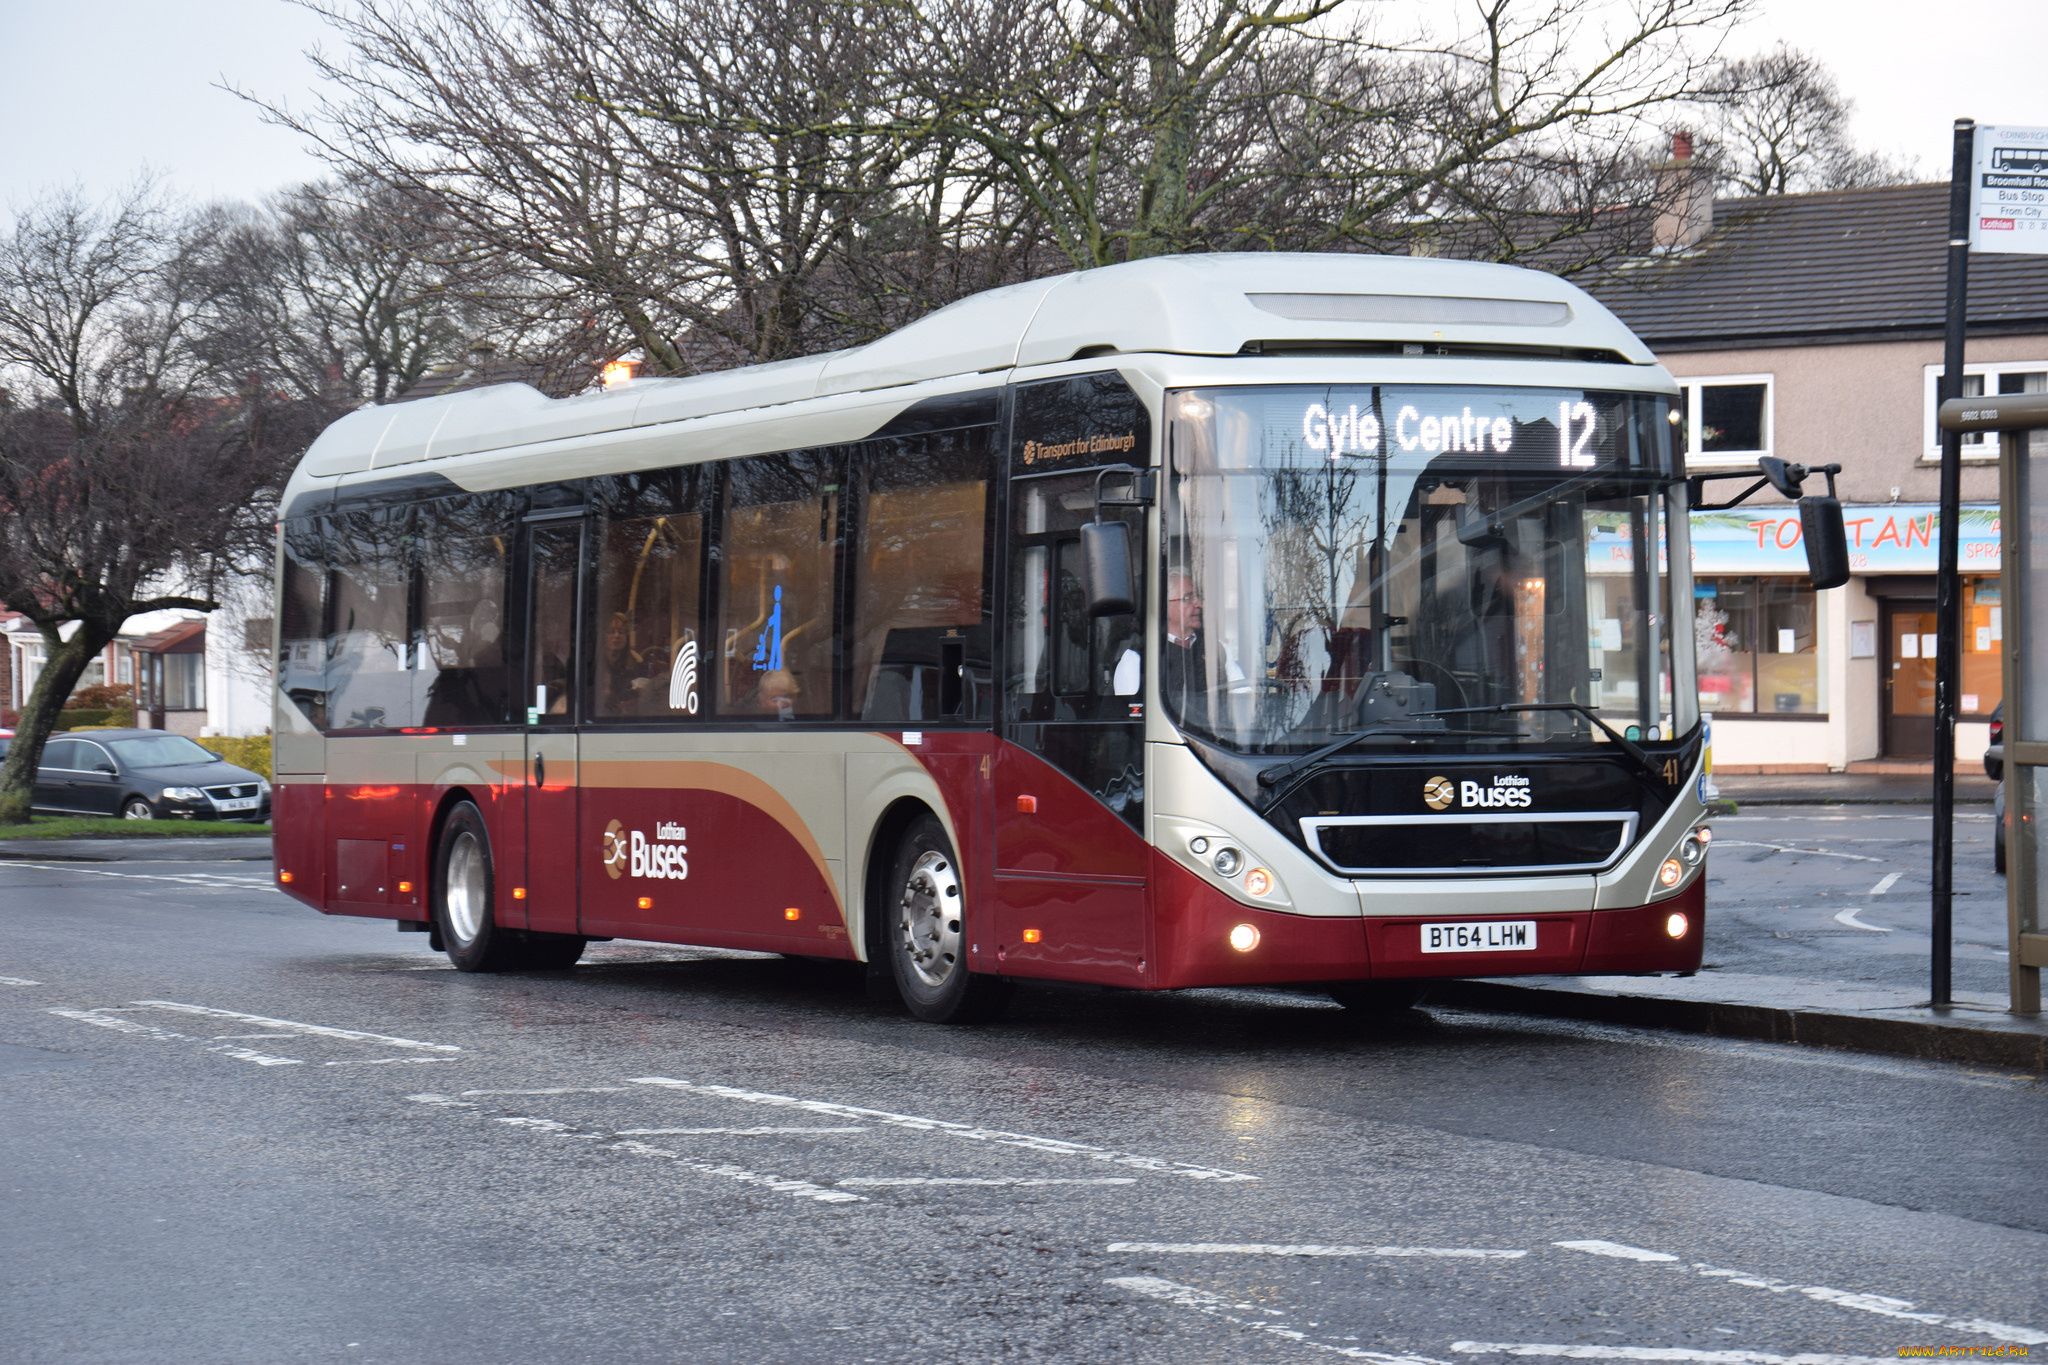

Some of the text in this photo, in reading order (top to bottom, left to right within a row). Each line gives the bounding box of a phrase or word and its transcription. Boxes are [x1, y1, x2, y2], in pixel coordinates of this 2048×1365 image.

[1986, 175, 2048, 188] Broomhall Roa
[1999, 190, 2045, 203] Bus Stop
[1981, 219, 2013, 229] Lothian
[2000, 206, 2042, 219] From City
[1035, 431, 1135, 460] Transport for Edinburgh
[1303, 401, 1596, 467] Gyle Centre 12
[1844, 513, 1934, 548] TAN
[980, 754, 990, 779] 41
[1662, 759, 1678, 785] 41
[1494, 774, 1529, 786] Lothian
[1460, 780, 1532, 808] Buses
[656, 821, 686, 840] Lothian
[630, 830, 688, 880] Buses
[1430, 924, 1527, 948] BT64 LHW
